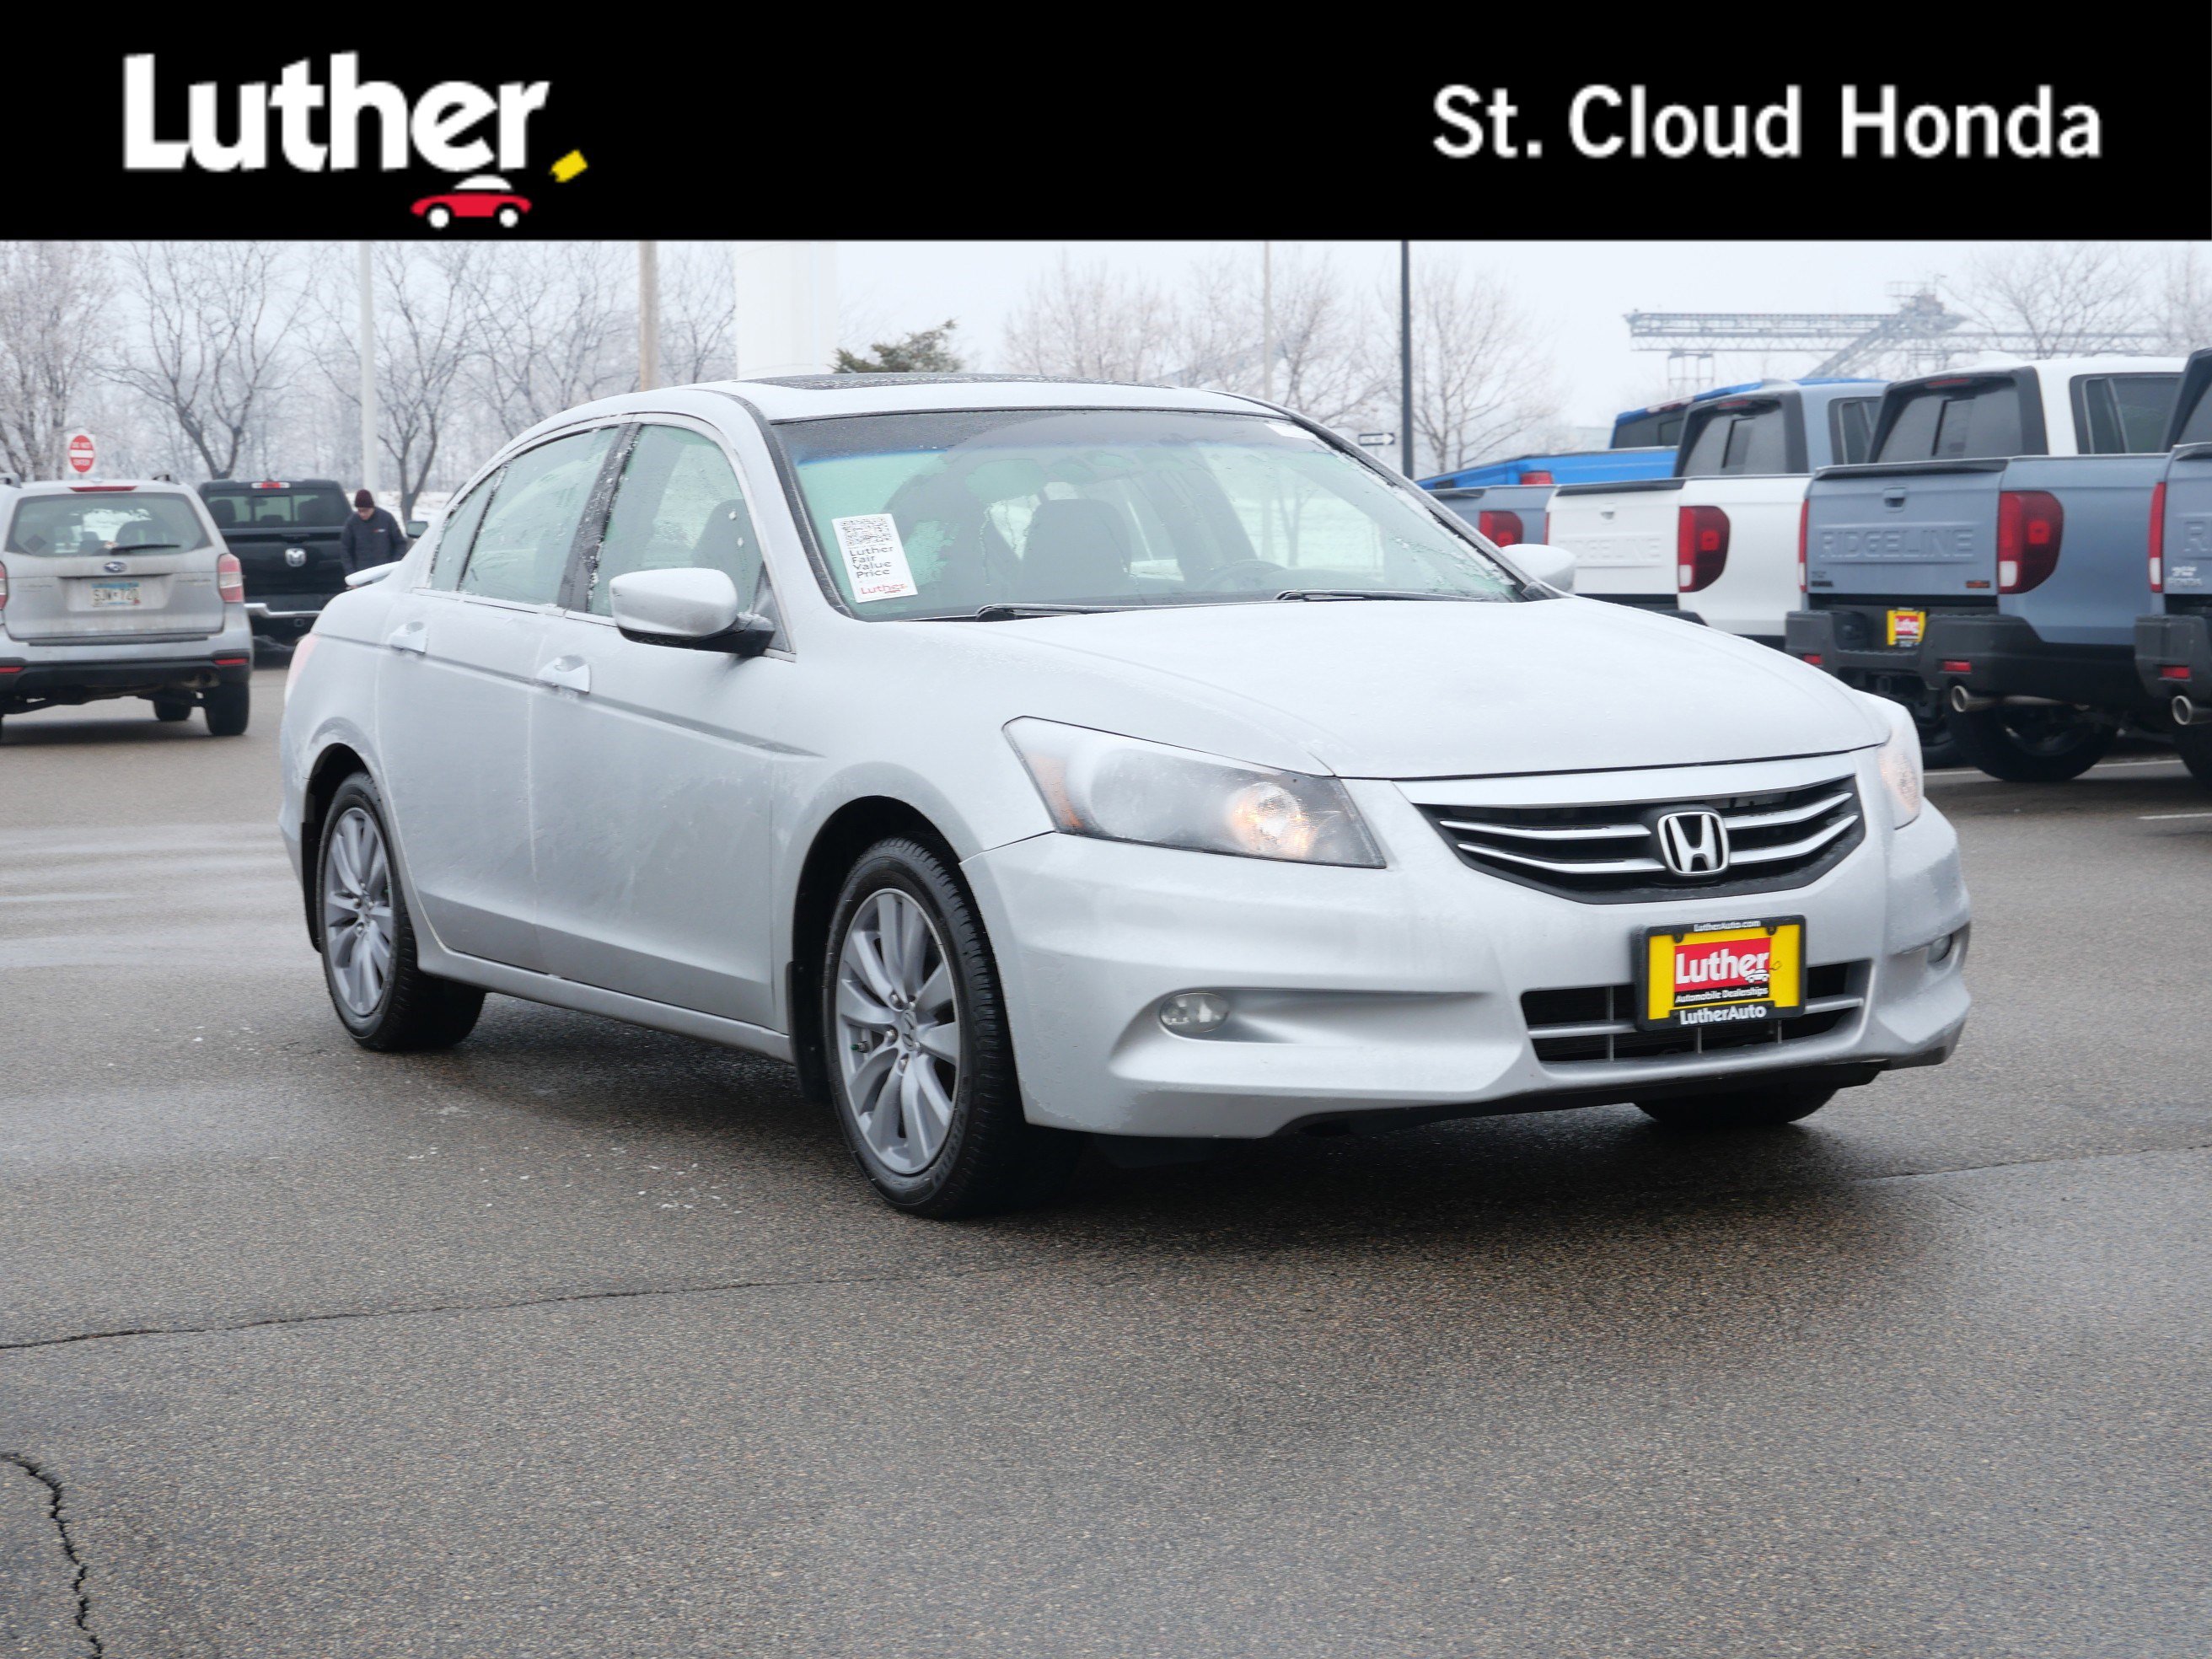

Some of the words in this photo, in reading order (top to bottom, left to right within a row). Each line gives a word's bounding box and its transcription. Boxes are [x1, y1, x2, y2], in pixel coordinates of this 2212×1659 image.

[1820, 529, 1973, 558] RIDGELINE
[850, 546, 894, 556] Luther
[852, 556, 875, 564] Fair
[853, 561, 892, 571] Value
[856, 569, 890, 579] Price
[861, 583, 908, 594] Luther
[1693, 921, 1762, 932] LutherAuto.com
[1675, 948, 1770, 985] Luther
[1674, 991, 1721, 1003] Automobile
[1679, 1004, 1768, 1025] LutherAuto
